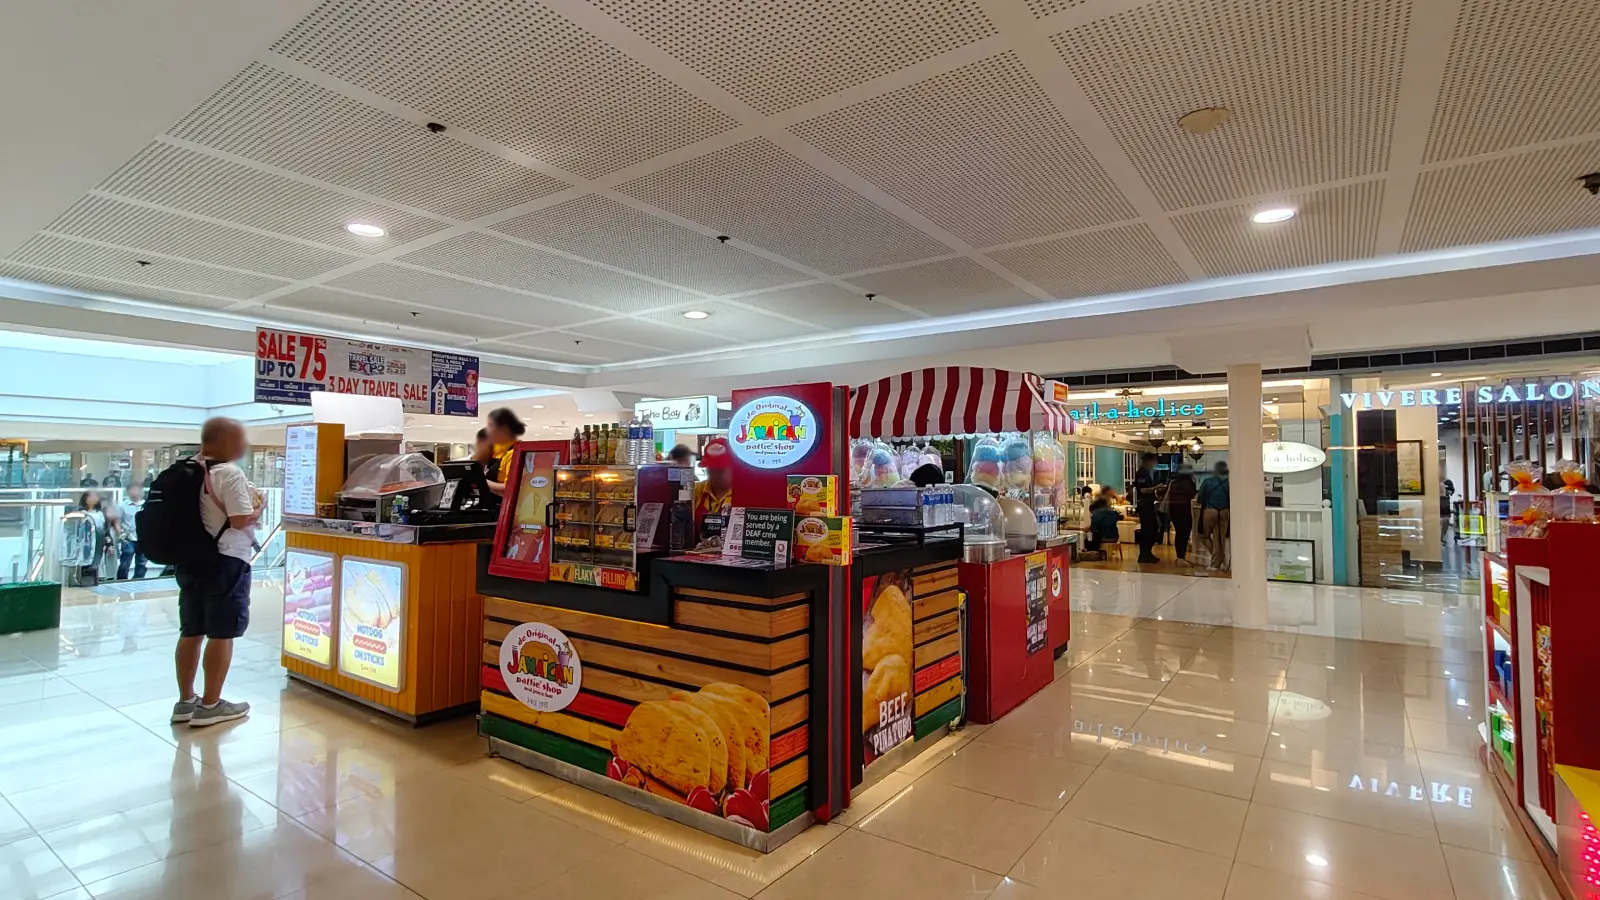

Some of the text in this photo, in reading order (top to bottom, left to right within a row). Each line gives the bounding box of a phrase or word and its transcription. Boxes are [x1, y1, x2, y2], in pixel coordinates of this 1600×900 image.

[257, 331, 296, 362] SALE
[258, 360, 296, 379] UP TO
[329, 376, 428, 402] 3 DAY TRAVEL SALE
[1340, 380, 1600, 409] VIVERE SALON
[774, 443, 794, 451] shop
[746, 513, 758, 521] You
[770, 513, 788, 524] being
[766, 522, 775, 531] by
[745, 529, 777, 539] DEAF crew
[744, 539, 772, 547] member.
[575, 568, 593, 582] FLAKY
[602, 571, 626, 586] FILLING
[356, 624, 384, 639] HOTDOG
[518, 629, 556, 646] de Original
[354, 649, 385, 666] ON STICKS
[516, 676, 562, 695] pattie shop
[879, 691, 908, 728] BEEF
[873, 715, 912, 756] PINATUBO
